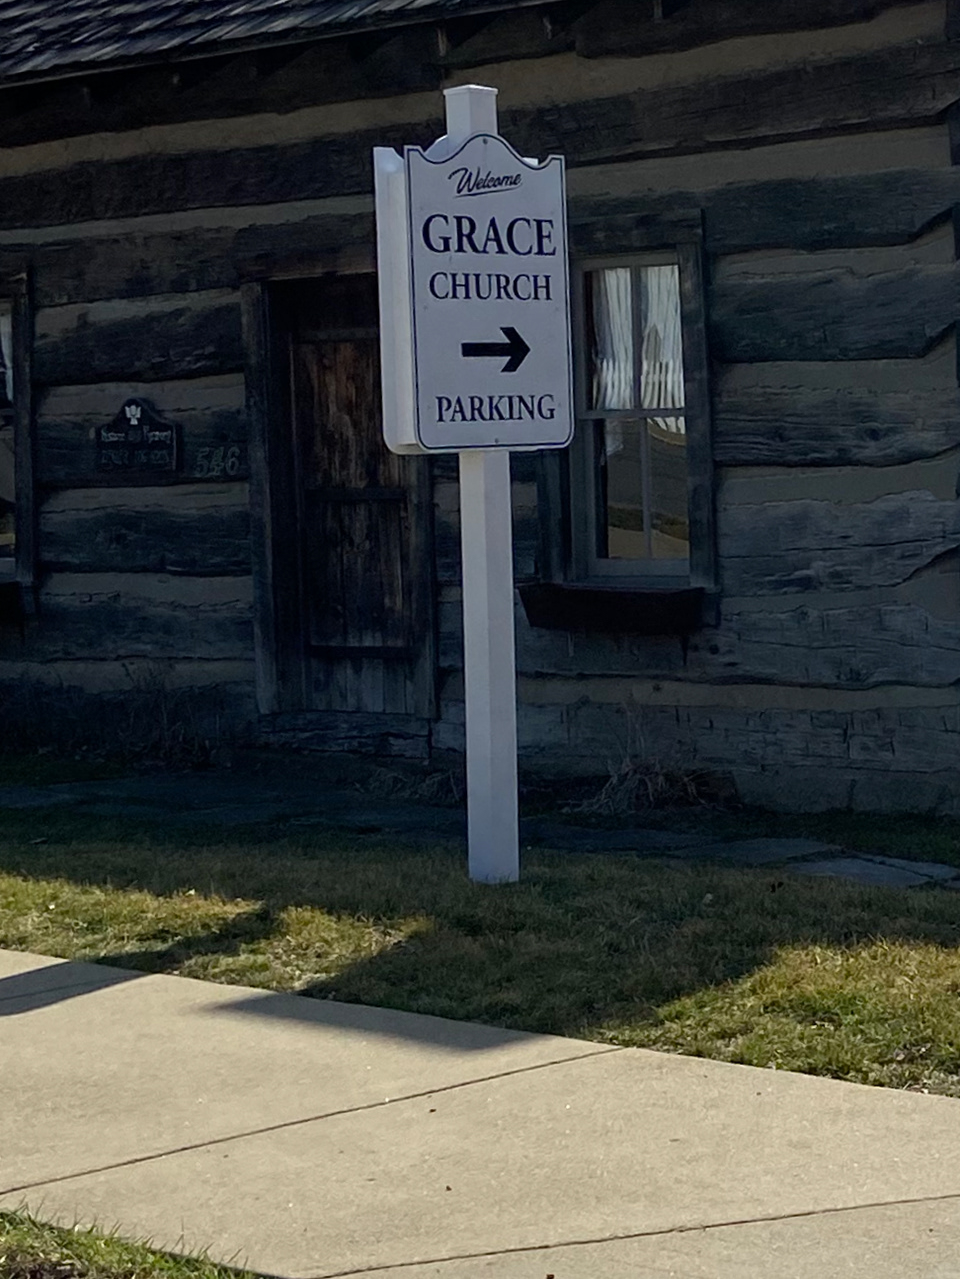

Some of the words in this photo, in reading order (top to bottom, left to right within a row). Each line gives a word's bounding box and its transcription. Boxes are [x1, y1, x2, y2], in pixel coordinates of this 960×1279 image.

[447, 166, 523, 194] Welcome
[422, 214, 556, 257] GRACE
[429, 272, 553, 301] CHURCH
[436, 395, 556, 423] PARKING
